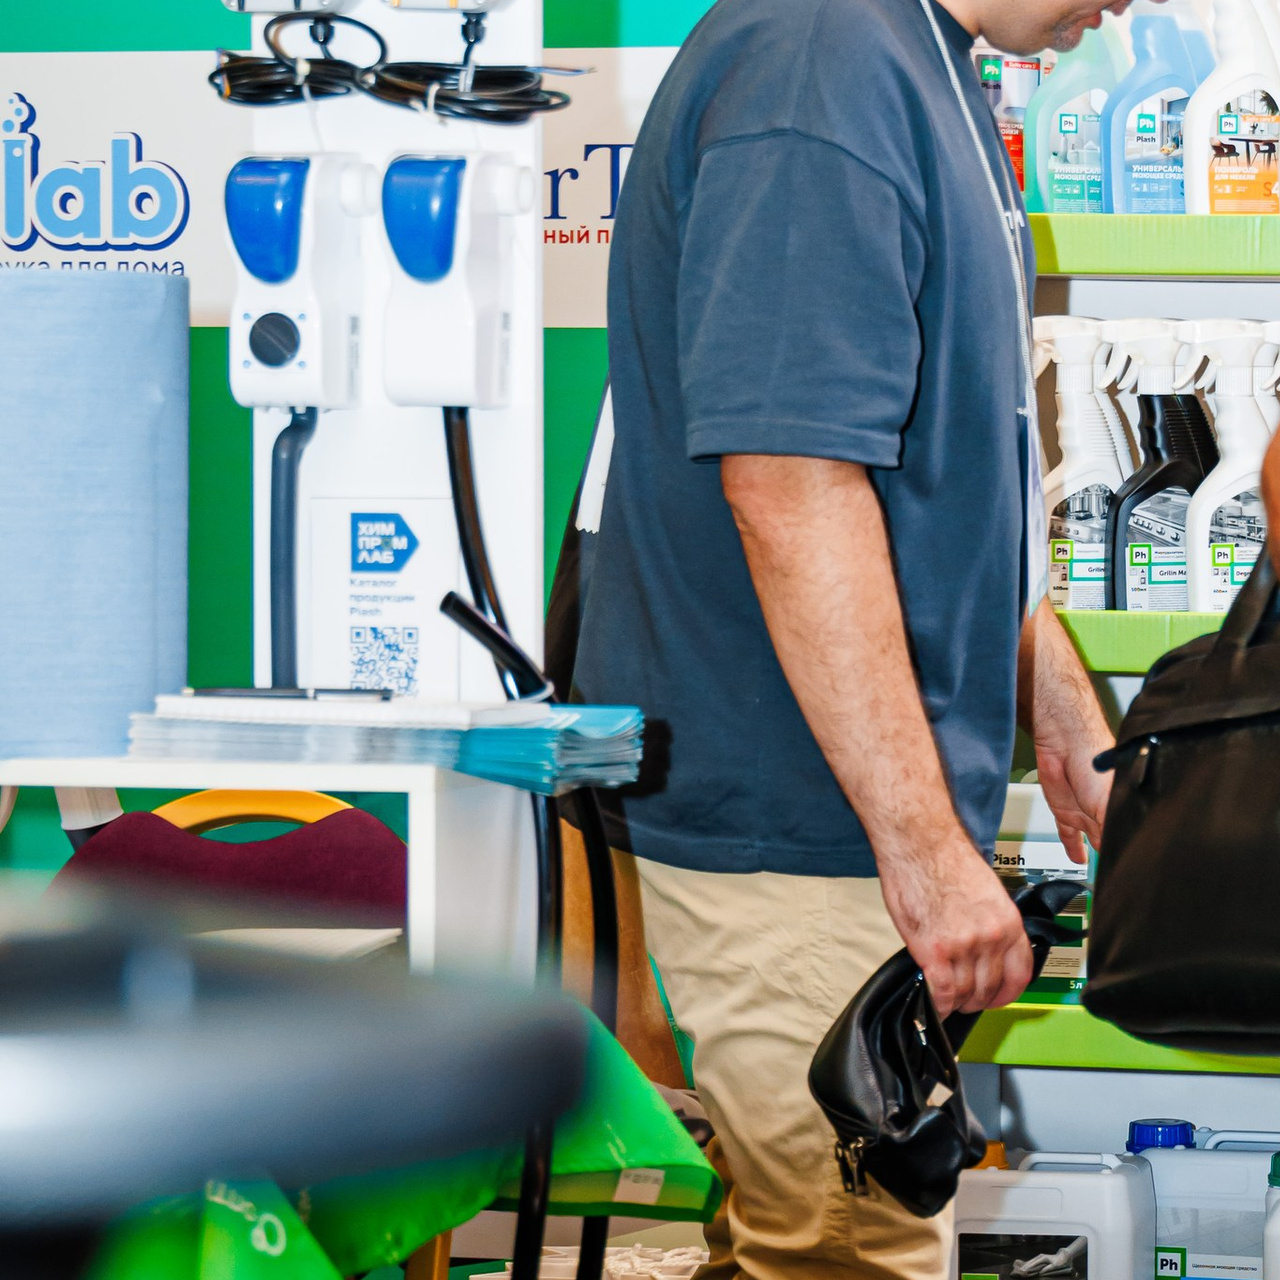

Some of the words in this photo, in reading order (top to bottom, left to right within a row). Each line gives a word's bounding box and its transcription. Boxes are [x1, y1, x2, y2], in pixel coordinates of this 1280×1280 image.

[357, 522, 395, 536] ХИМ
[1056, 547, 1068, 556] Ph
[1134, 551, 1147, 559] Ph
[1217, 551, 1229, 559] Ph
[357, 550, 395, 564] ЛАБ
[1069, 980, 1083, 990] 5л
[1160, 1258, 1179, 1271] Ph
